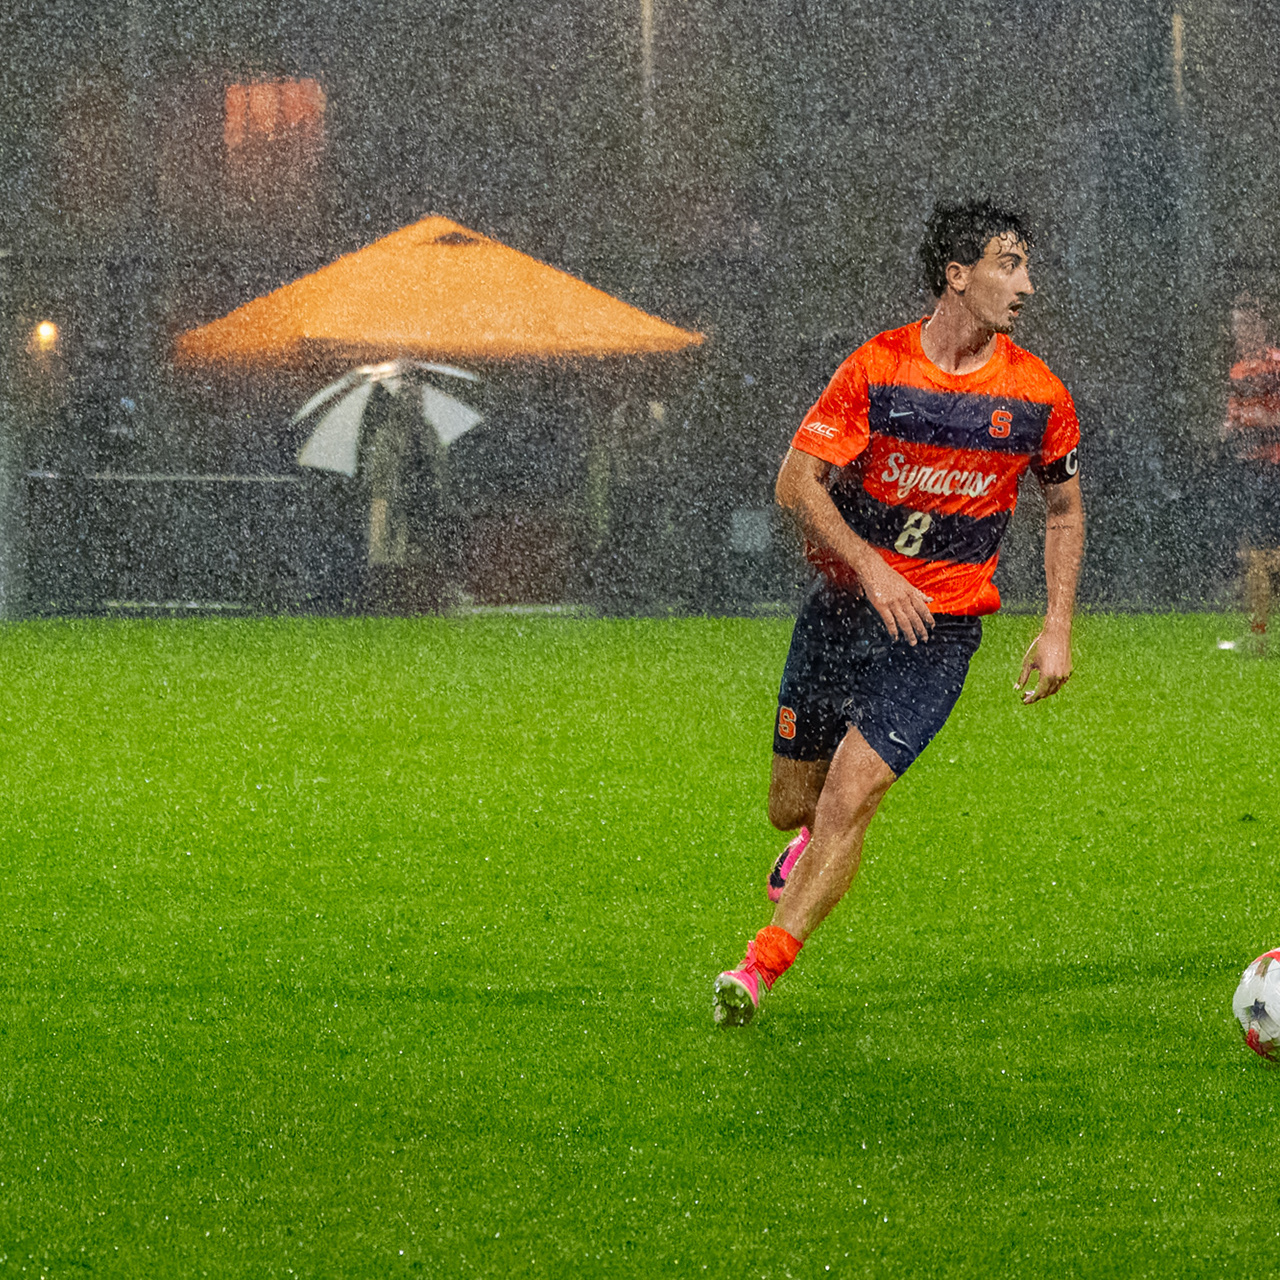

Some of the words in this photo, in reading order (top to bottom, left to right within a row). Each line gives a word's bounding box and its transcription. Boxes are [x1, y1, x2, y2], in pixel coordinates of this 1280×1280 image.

[803, 421, 841, 439] ACC
[988, 409, 1013, 439] S
[881, 452, 998, 499] Syracuse
[894, 510, 933, 557] 8
[778, 705, 797, 740] S
